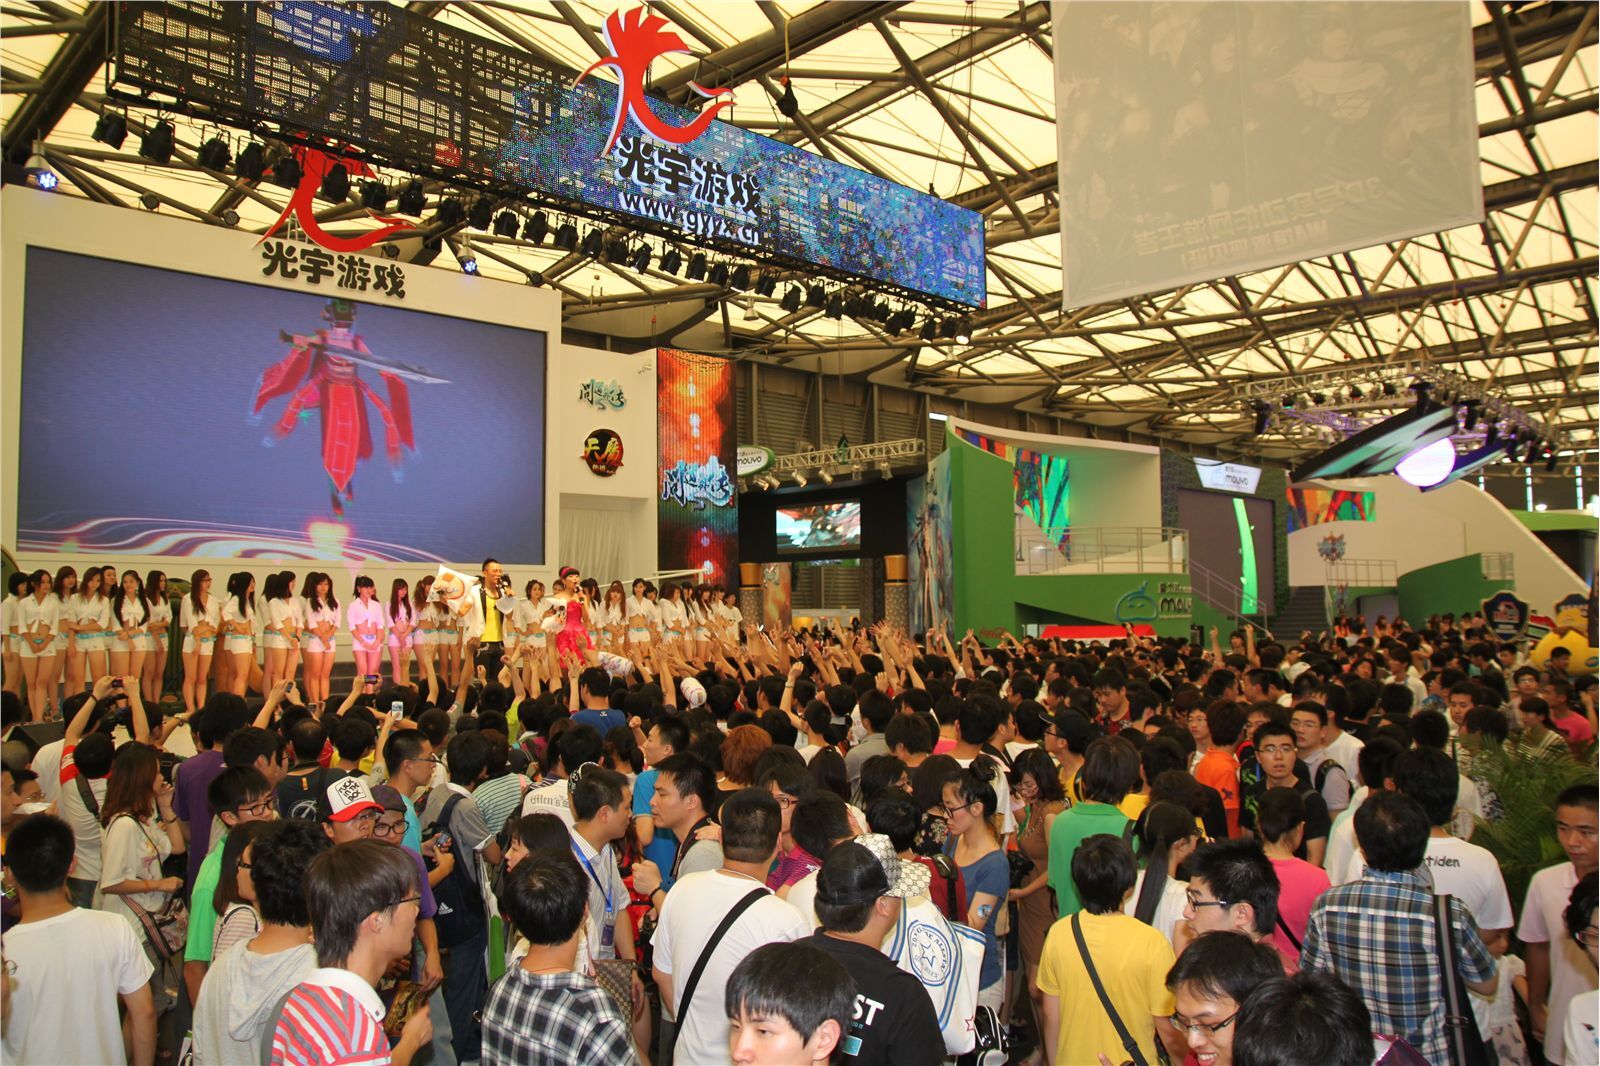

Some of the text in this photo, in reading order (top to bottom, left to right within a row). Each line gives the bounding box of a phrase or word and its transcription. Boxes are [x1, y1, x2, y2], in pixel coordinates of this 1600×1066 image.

[616, 136, 761, 217] 光宇游戏
[619, 191, 760, 247] www.gyyx.cn
[262, 241, 406, 299] 光宇游戏
